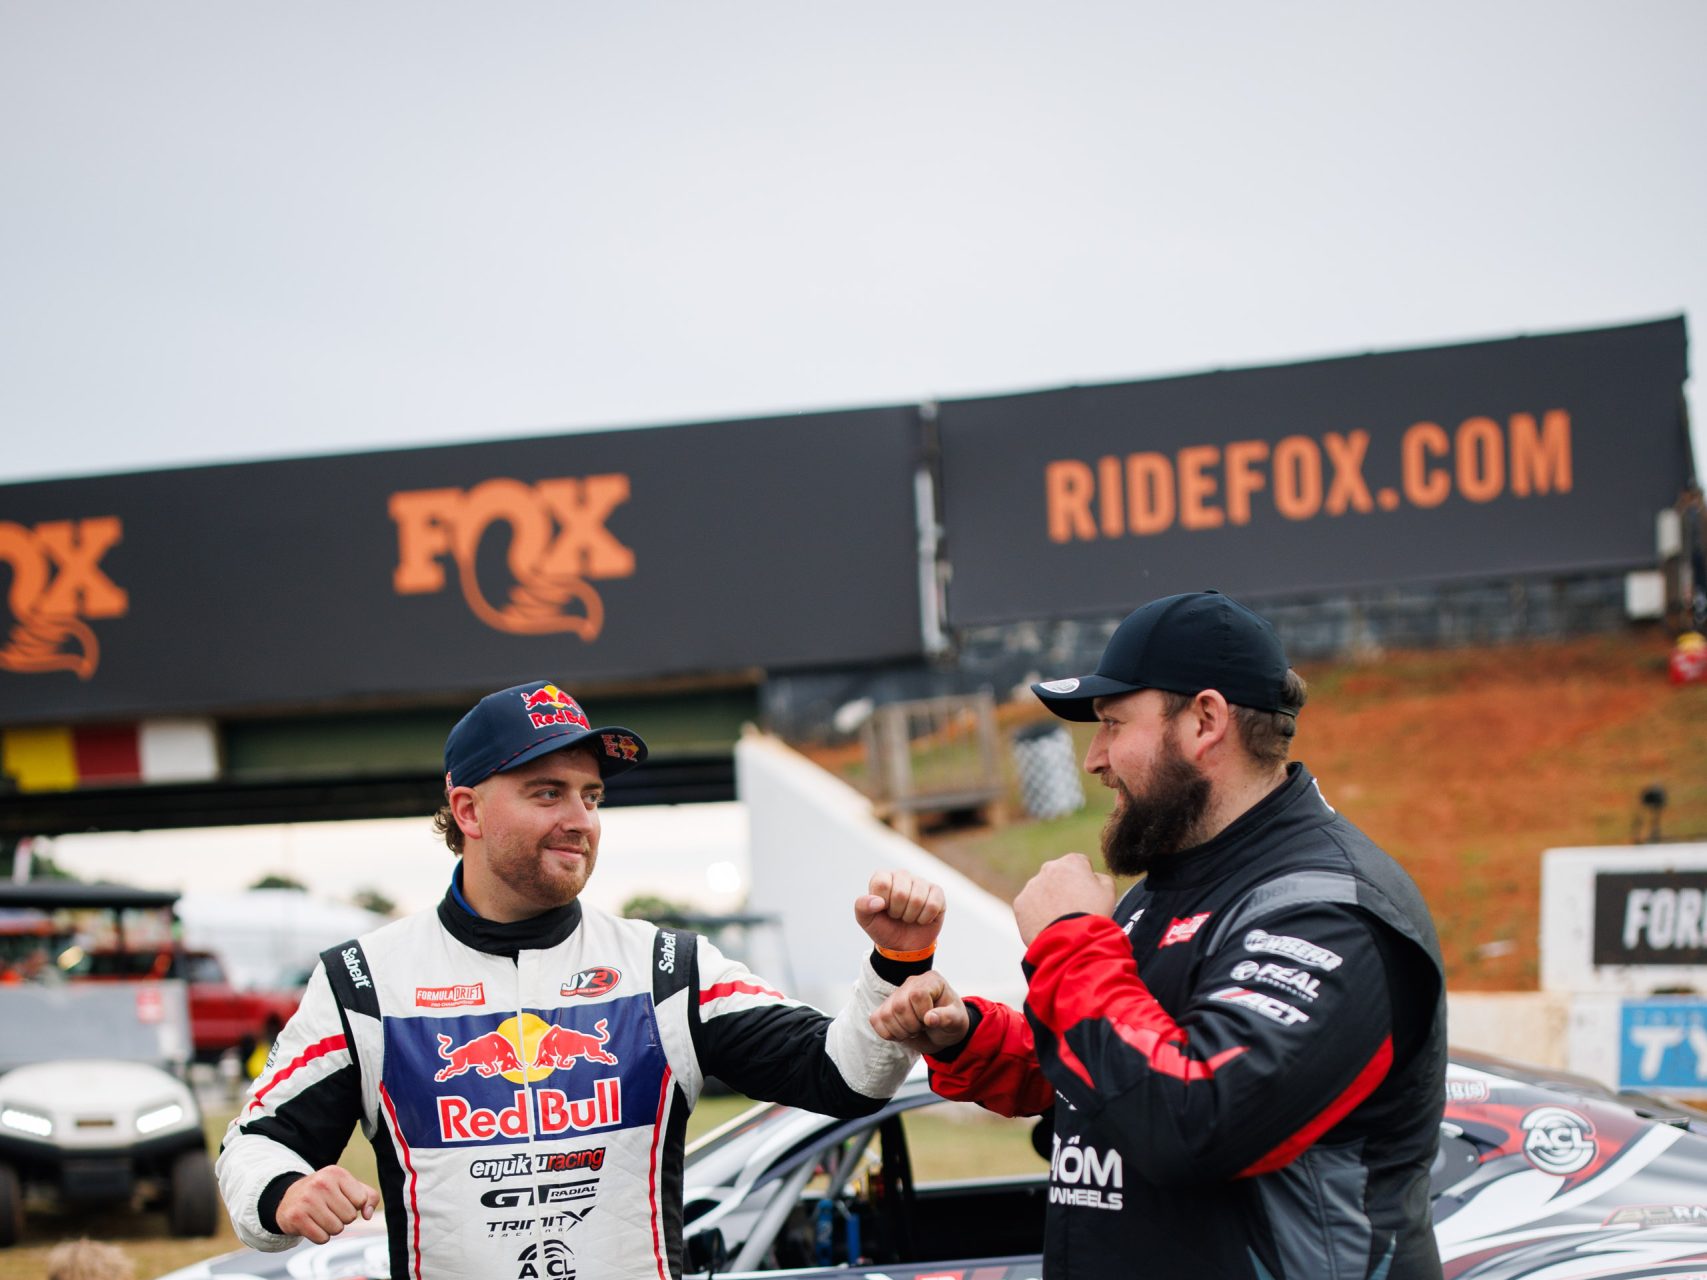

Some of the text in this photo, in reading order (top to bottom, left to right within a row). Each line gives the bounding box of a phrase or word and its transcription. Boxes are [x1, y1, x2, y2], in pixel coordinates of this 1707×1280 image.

[1045, 408, 1573, 543] RIDEFOX.COM
[388, 473, 635, 641] FOX
[529, 709, 566, 729] Red
[1622, 887, 1707, 950] FOR
[341, 947, 371, 989] Sabelt
[1258, 963, 1320, 999] FEAL
[416, 985, 480, 1000] FORMULA DRIFT
[438, 1078, 622, 1142] Red Bull
[1525, 1127, 1594, 1150] ACL
[480, 1183, 598, 1208] GT RADIAL
[1049, 1186, 1123, 1211] WHEELS
[486, 1205, 597, 1232] TRINITY
[518, 1257, 577, 1279] ACL
